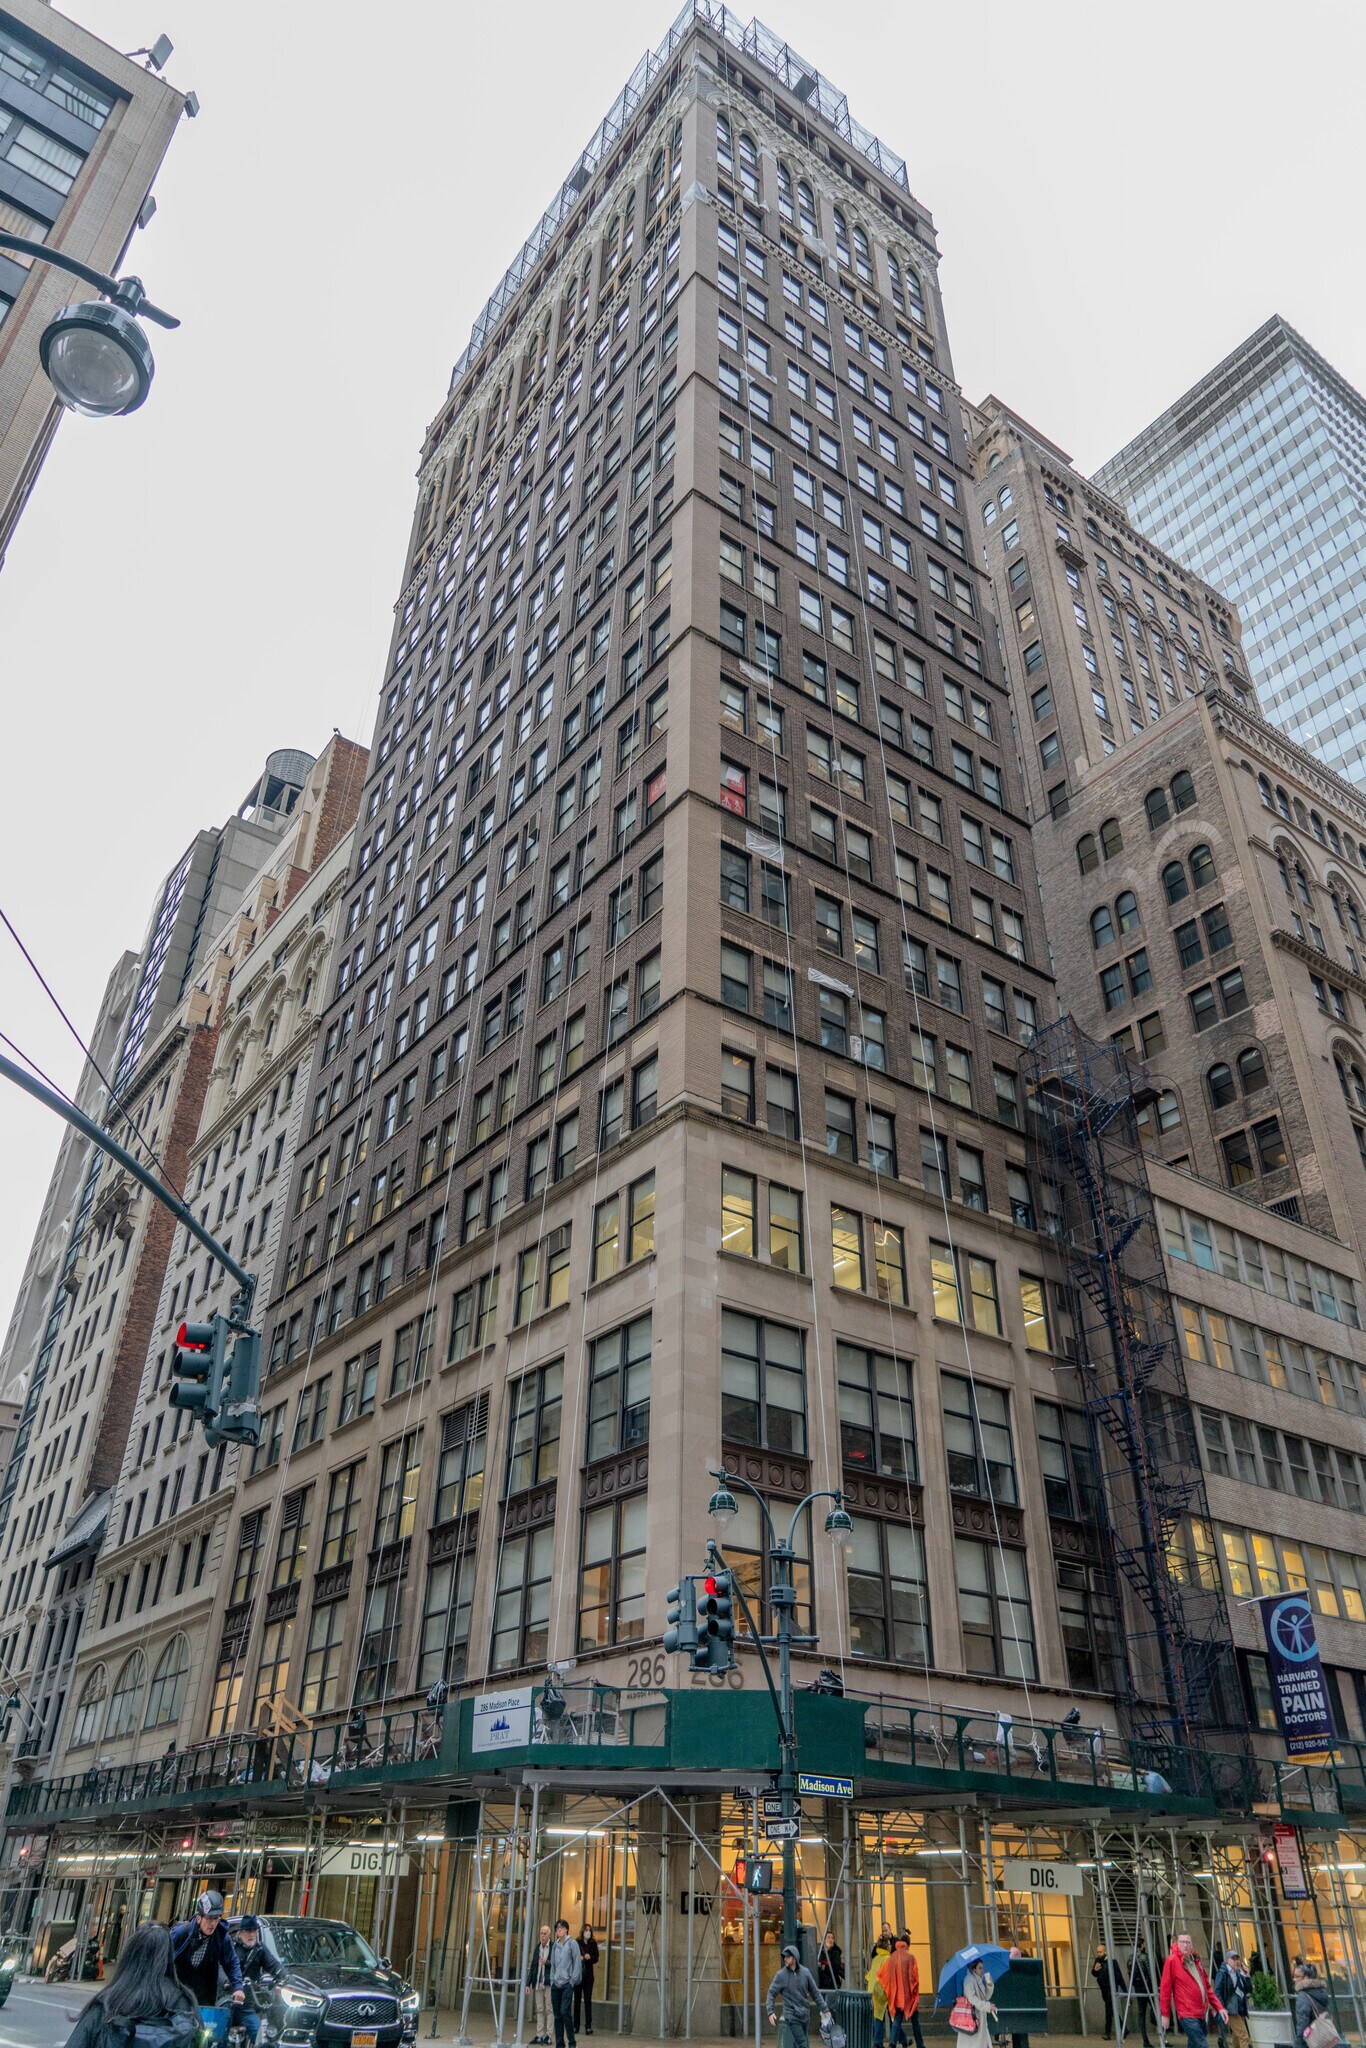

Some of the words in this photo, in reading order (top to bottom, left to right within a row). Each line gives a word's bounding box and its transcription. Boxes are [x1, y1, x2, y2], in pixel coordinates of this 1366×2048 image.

[627, 1654, 665, 1688] 286
[1277, 1670, 1318, 1683] HARVARD
[1280, 1681, 1320, 1694] TRAINED
[489, 1700, 508, 1710] Madison
[508, 1698, 520, 1707] Place
[1281, 1692, 1325, 1713] PAIN
[1285, 1711, 1327, 1724] DOCTORS
[1290, 1741, 1304, 1751] (212)
[1304, 1739, 1328, 1749] 920-54
[800, 1778, 835, 1793] Madison
[837, 1783, 852, 1794] Ave
[767, 1803, 780, 1812] ONE
[257, 1821, 278, 1833] 286
[770, 1825, 780, 1834] ONE
[785, 1825, 795, 1833] WAY
[1030, 1868, 1058, 1888] DIG.
